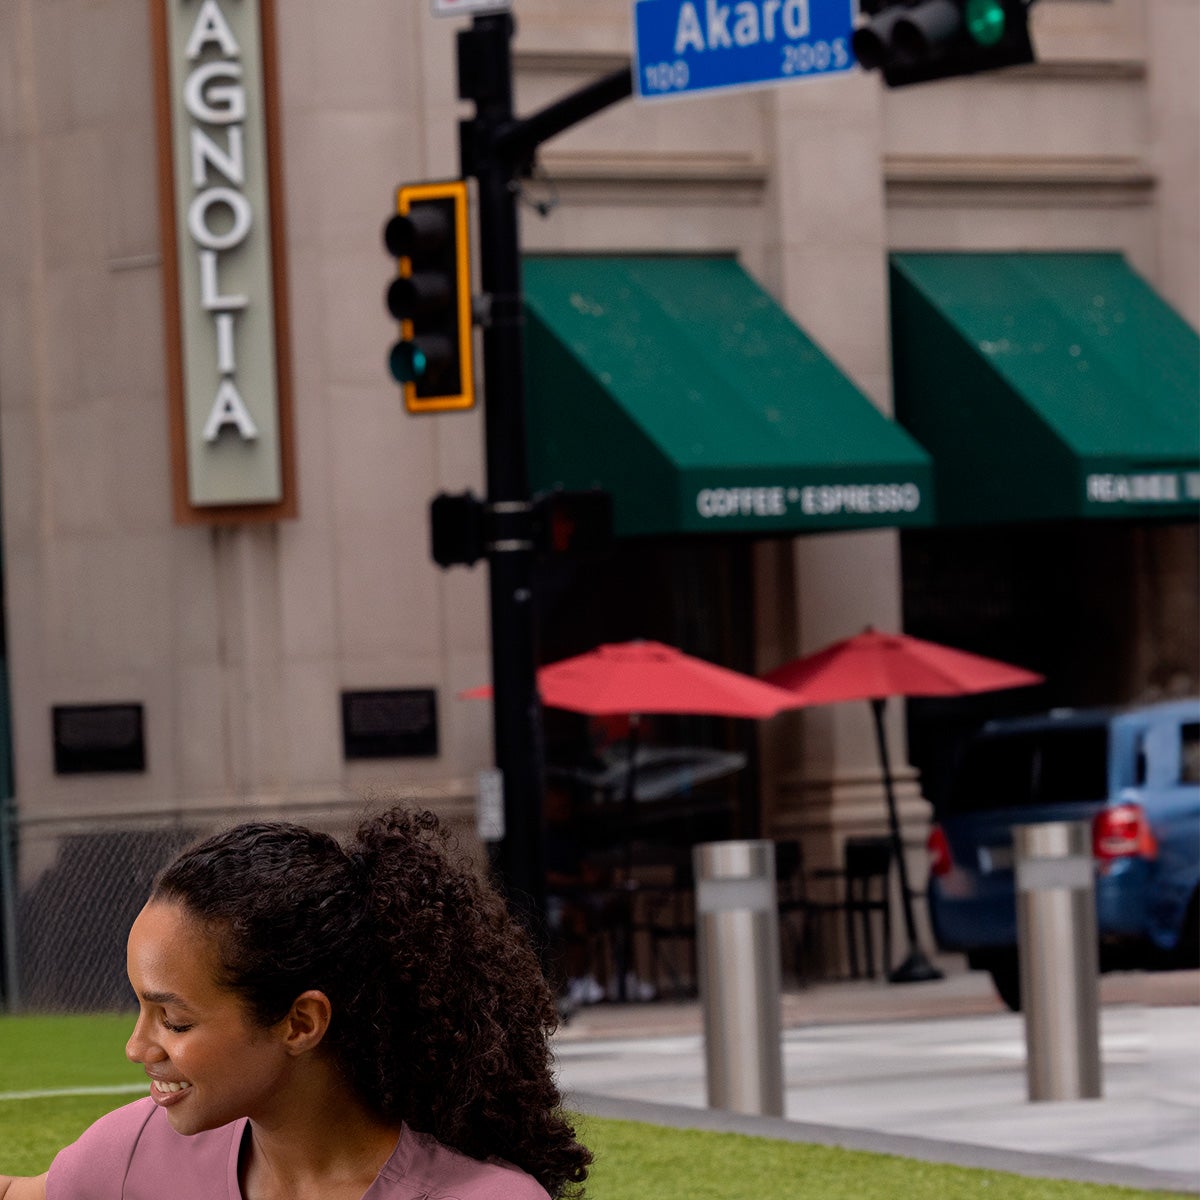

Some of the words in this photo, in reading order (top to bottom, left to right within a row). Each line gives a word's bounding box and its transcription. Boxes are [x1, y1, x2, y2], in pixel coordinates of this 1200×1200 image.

[674, 0, 810, 54] Akard
[184, 0, 258, 442] AGNOLIA
[696, 486, 787, 519] COFFEE
[801, 482, 921, 515] ESPRESSO
